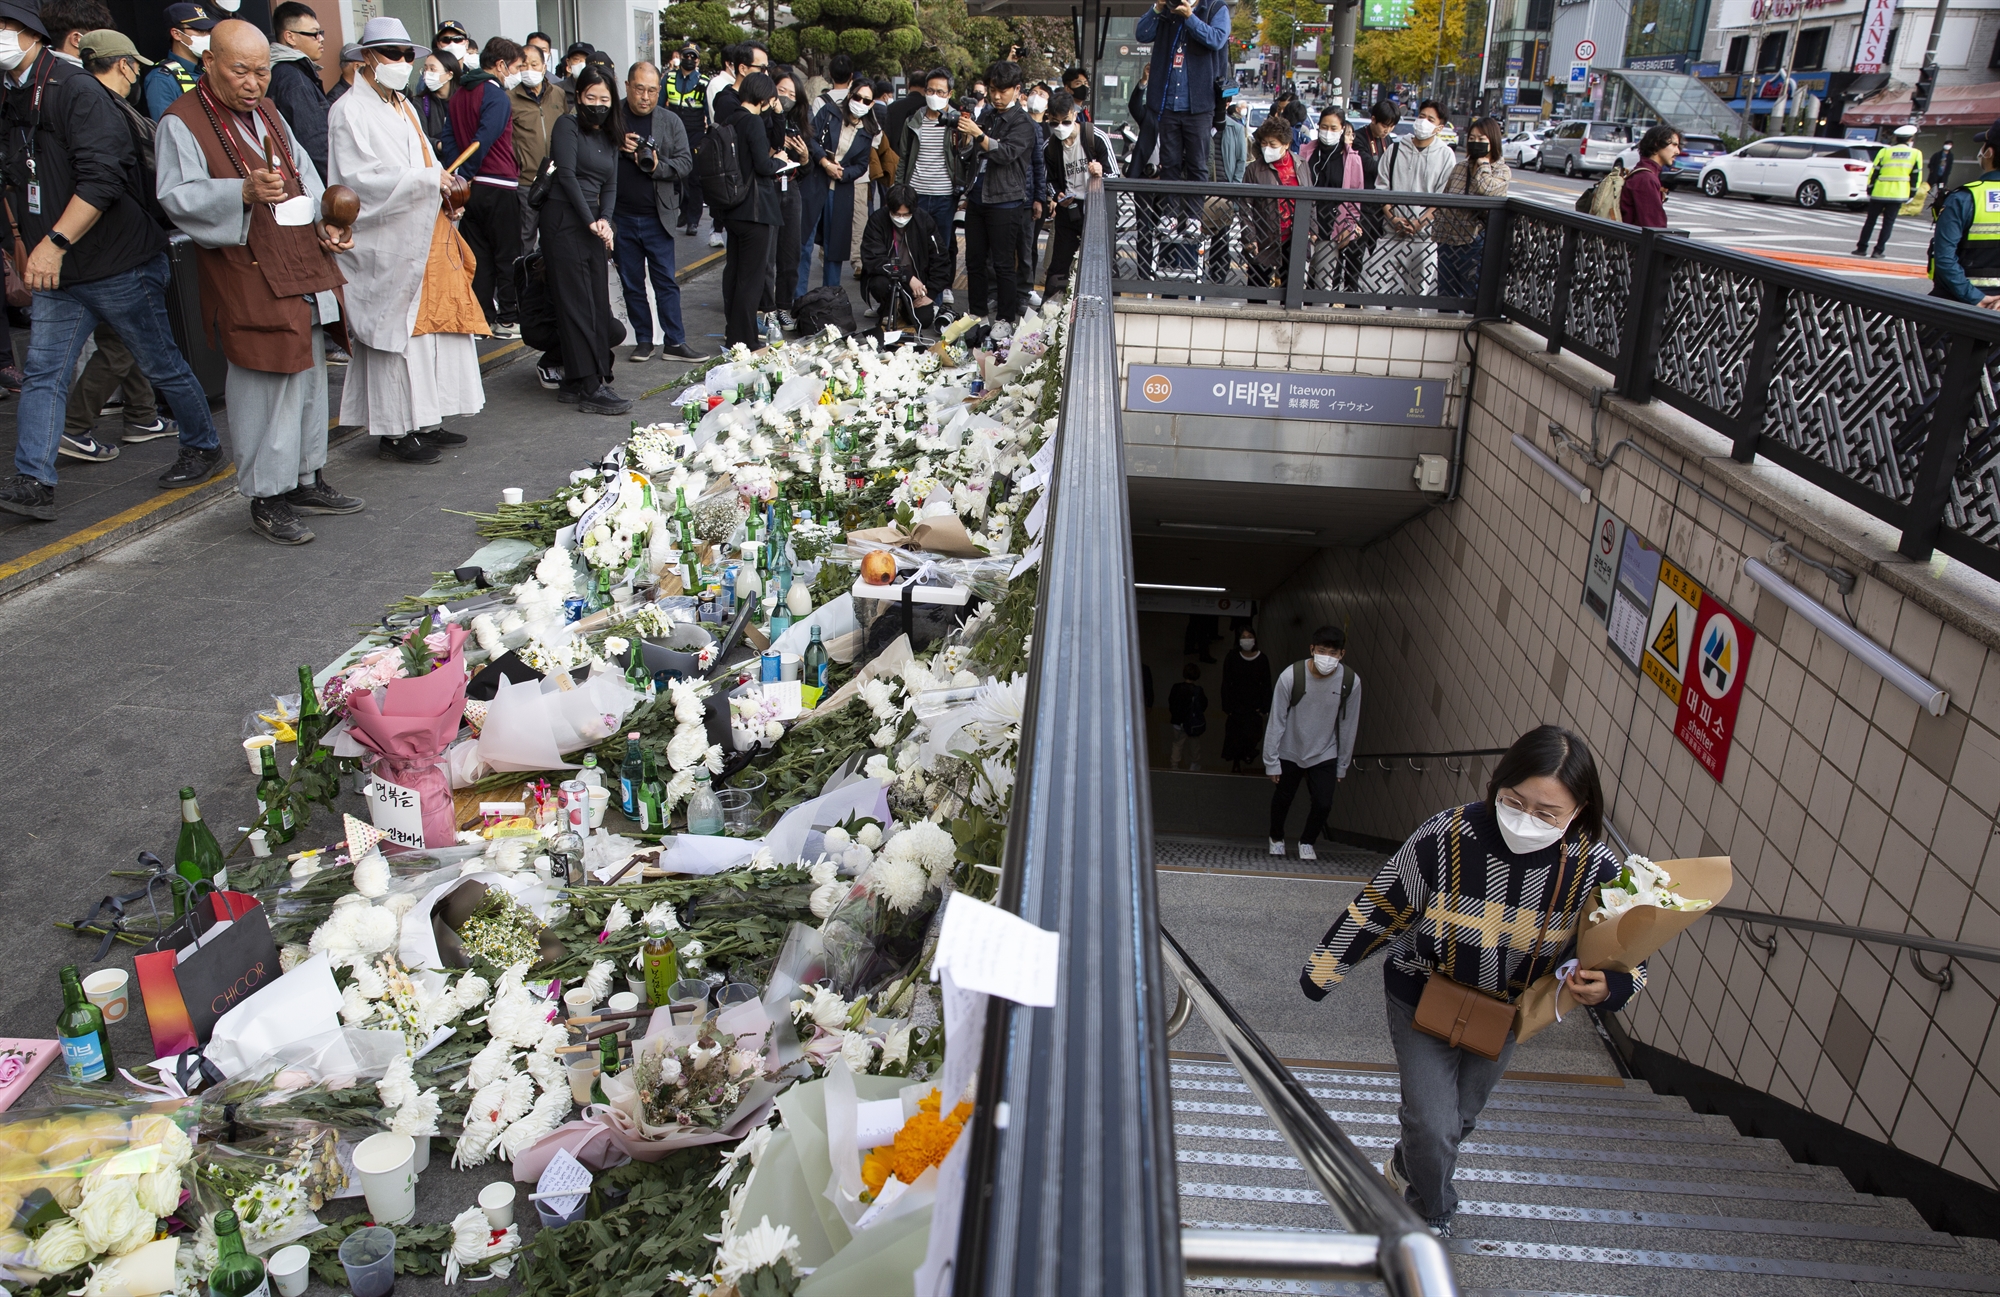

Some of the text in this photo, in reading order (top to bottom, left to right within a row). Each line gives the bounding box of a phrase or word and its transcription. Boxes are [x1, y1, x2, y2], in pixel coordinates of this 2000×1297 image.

[1580, 45, 1592, 56] 50
[1646, 59, 1676, 70] BAGUETTE
[1476, 100, 1482, 108] P
[1146, 382, 1169, 396] 630
[1212, 380, 1280, 408] 이태원
[1289, 384, 1336, 397] Itaewon
[1413, 386, 1422, 407] 1
[1288, 398, 1320, 410] 梨泰院
[1328, 400, 1374, 412] イテウォン
[1593, 554, 1612, 580] 금연구역
[1221, 600, 1227, 609] 6
[1646, 660, 1677, 697] 미끄럼주의
[1686, 687, 1725, 740] 대피소
[1688, 719, 1714, 752] shelter
[376, 782, 413, 807] 명복을
[211, 962, 266, 1014] CHICOR
